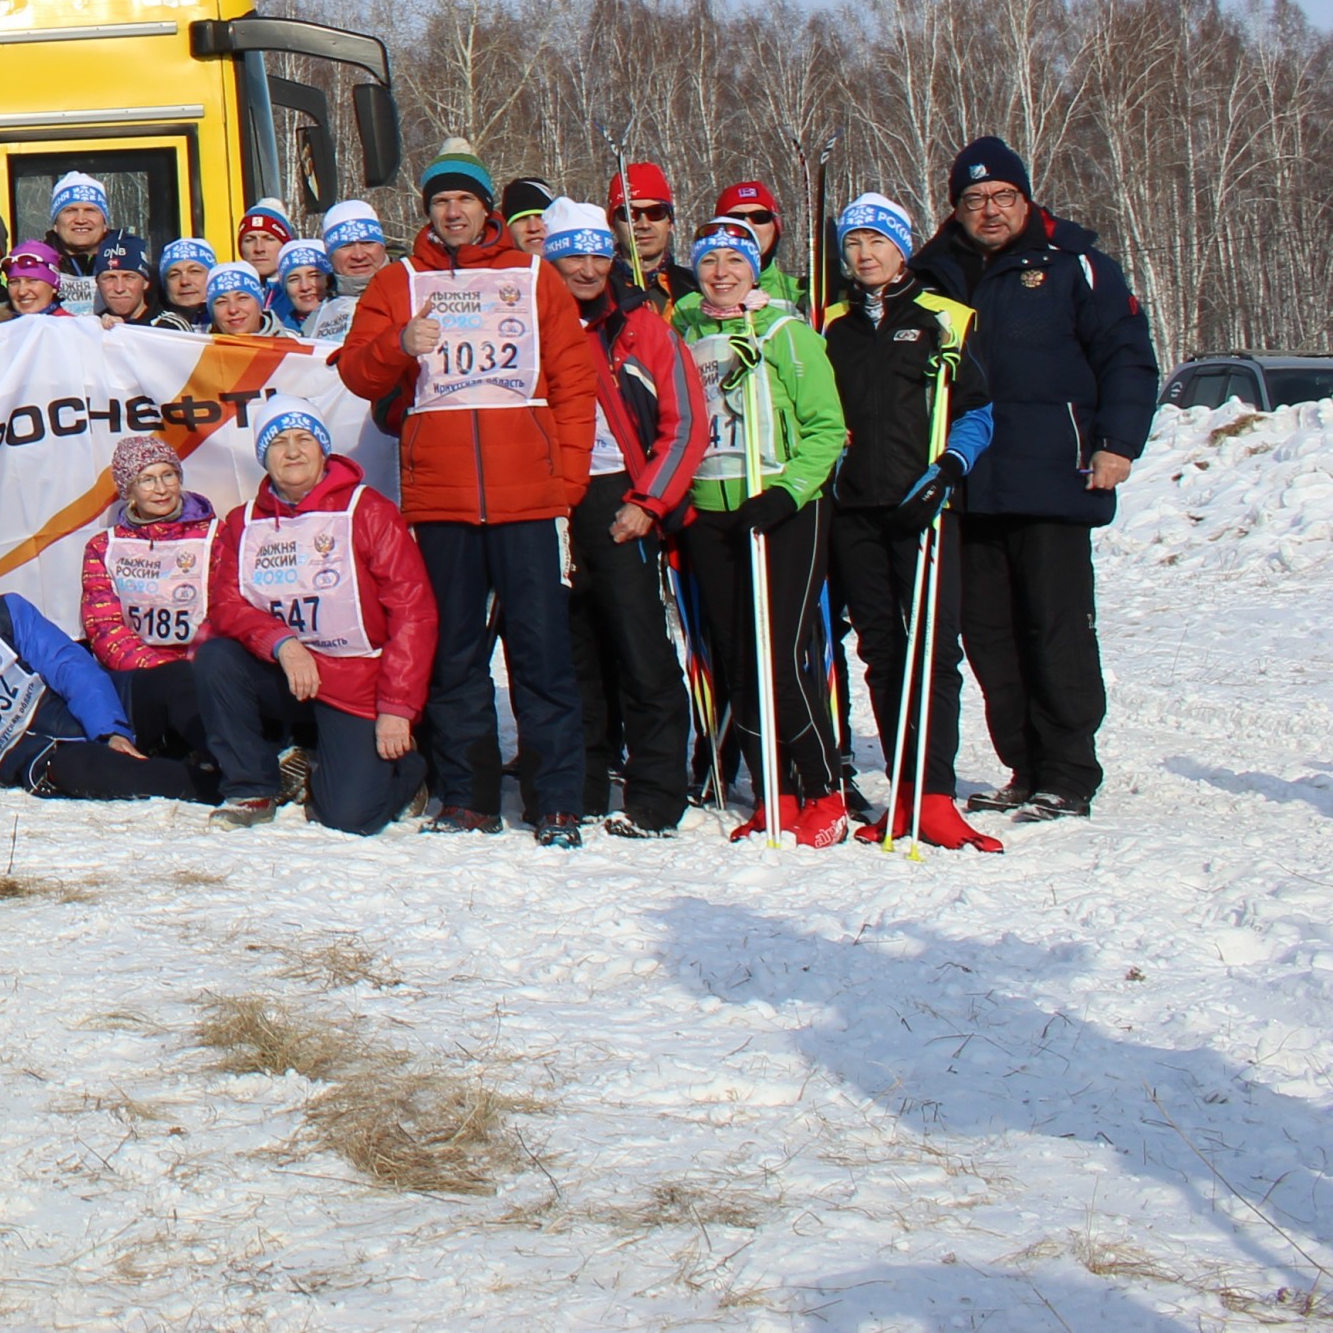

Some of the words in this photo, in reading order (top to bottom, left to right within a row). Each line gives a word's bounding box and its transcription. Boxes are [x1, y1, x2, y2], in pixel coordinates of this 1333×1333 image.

[103, 246, 127, 259] DNB
[436, 341, 518, 376] 1032
[433, 378, 484, 395] Иркутская
[485, 377, 525, 389] область
[255, 540, 298, 557] ЛЫЖНЯ
[116, 555, 162, 570] ЛЫЖНЯ
[254, 554, 298, 570] РОССИИ
[116, 565, 161, 580] РОССИИ
[252, 568, 299, 586] 2020
[117, 577, 160, 594] 2020
[127, 605, 191, 641] 5185
[18, 681, 36, 716] область
